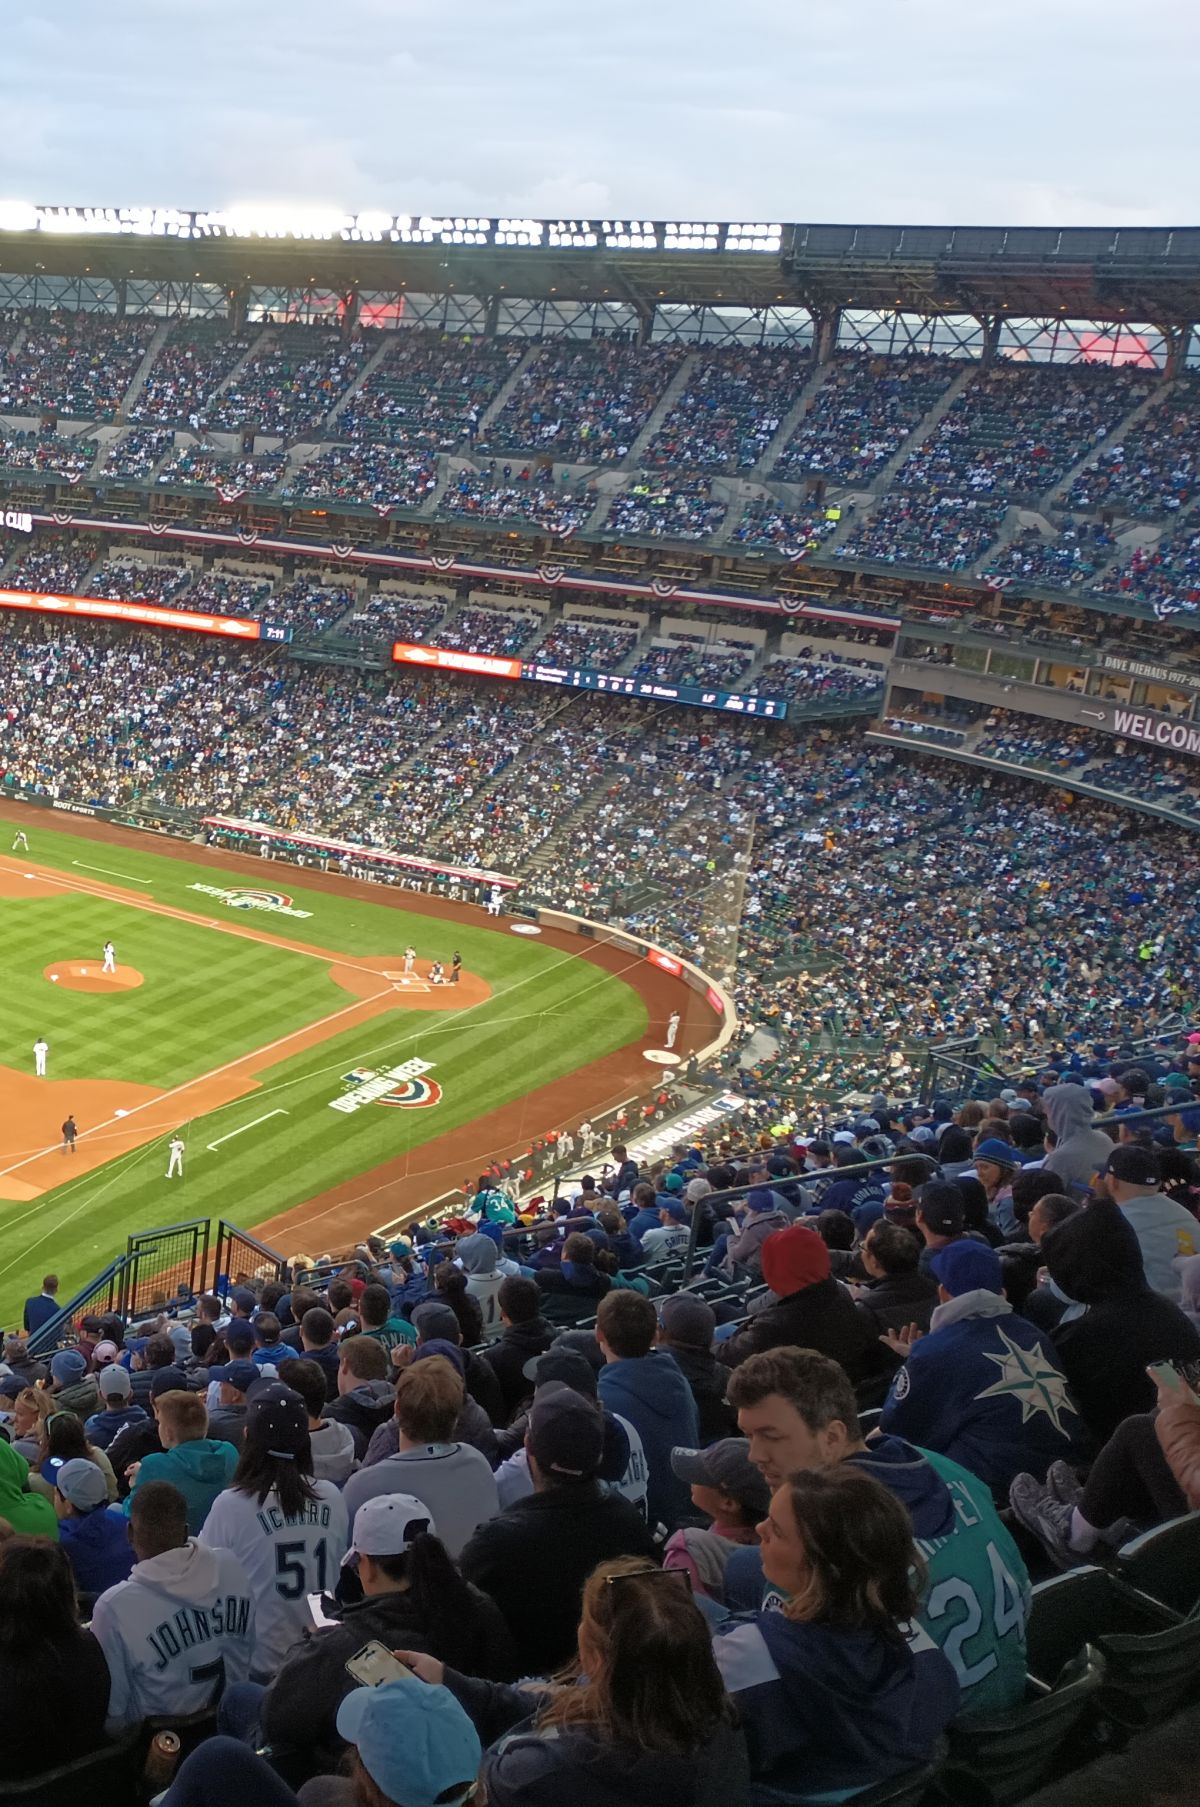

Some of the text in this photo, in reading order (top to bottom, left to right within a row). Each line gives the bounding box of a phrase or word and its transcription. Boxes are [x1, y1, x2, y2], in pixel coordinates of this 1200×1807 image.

[5, 512, 33, 533] CLUB
[266, 627, 285, 640] 7:11
[1104, 656, 1129, 671] DAVE
[1129, 662, 1167, 681] NIEHAUS
[53, 800, 95, 816] ROOT SPORTS
[328, 1056, 438, 1113] OPENING WEEK
[688, 1105, 726, 1129] PARK
[490, 1198, 510, 1211] 34
[274, 1537, 328, 1601] 51
[926, 1540, 1026, 1690] 24
[146, 1594, 251, 1673] JOHNSON
[187, 1656, 227, 1706] 7
